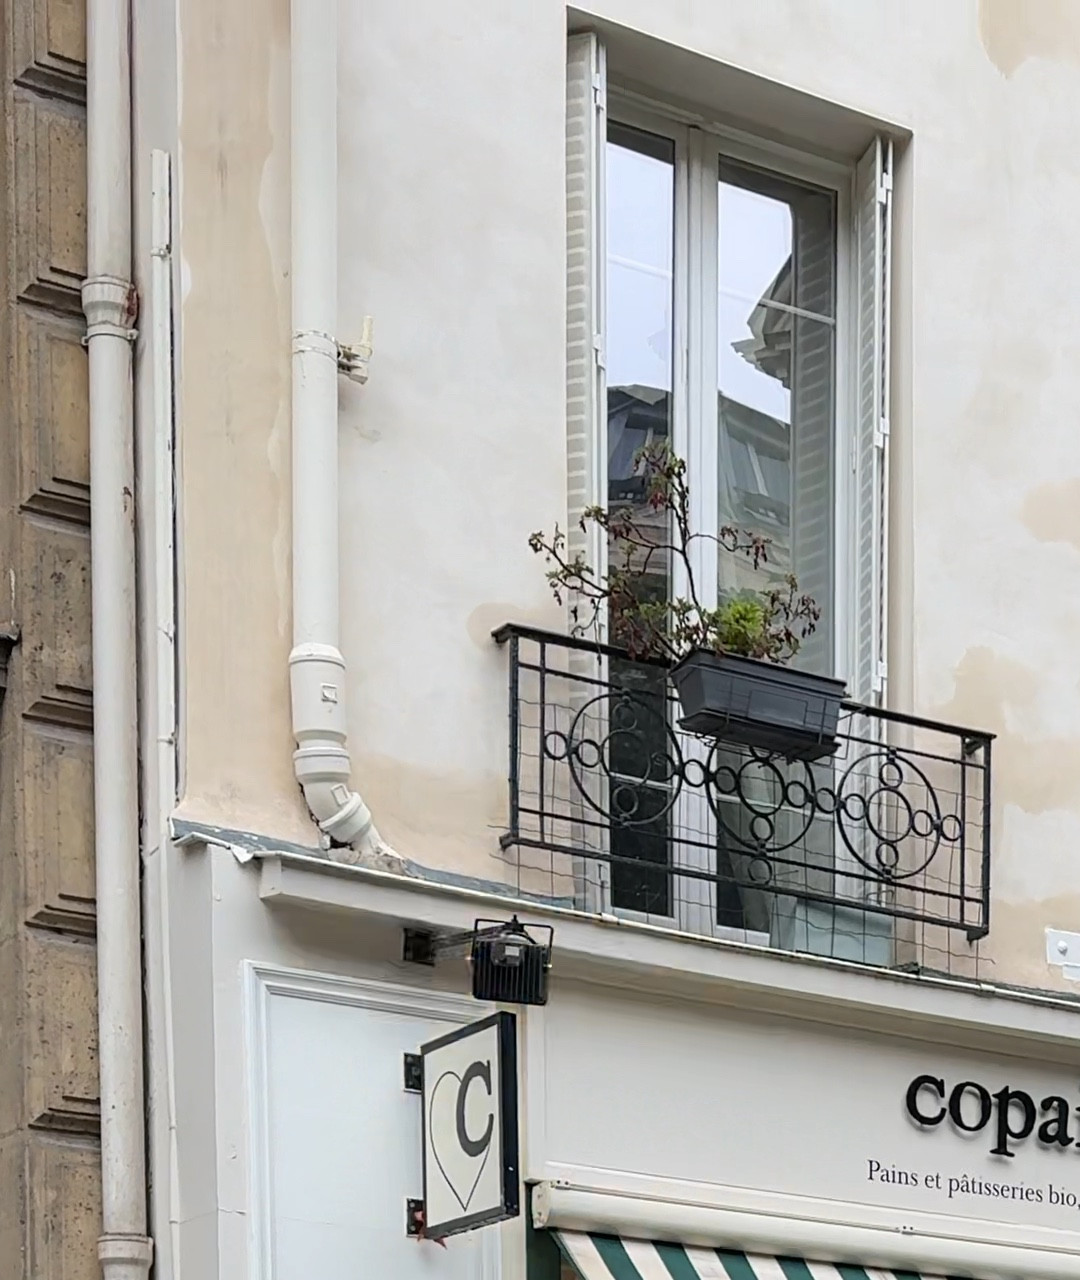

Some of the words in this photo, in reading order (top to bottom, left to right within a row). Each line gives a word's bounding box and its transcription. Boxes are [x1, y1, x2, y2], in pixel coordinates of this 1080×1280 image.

[456, 1060, 494, 1157] C
[867, 1159, 919, 1187] Pains
[924, 1172, 942, 1189] et
[948, 1174, 1043, 1203] pâtisseries
